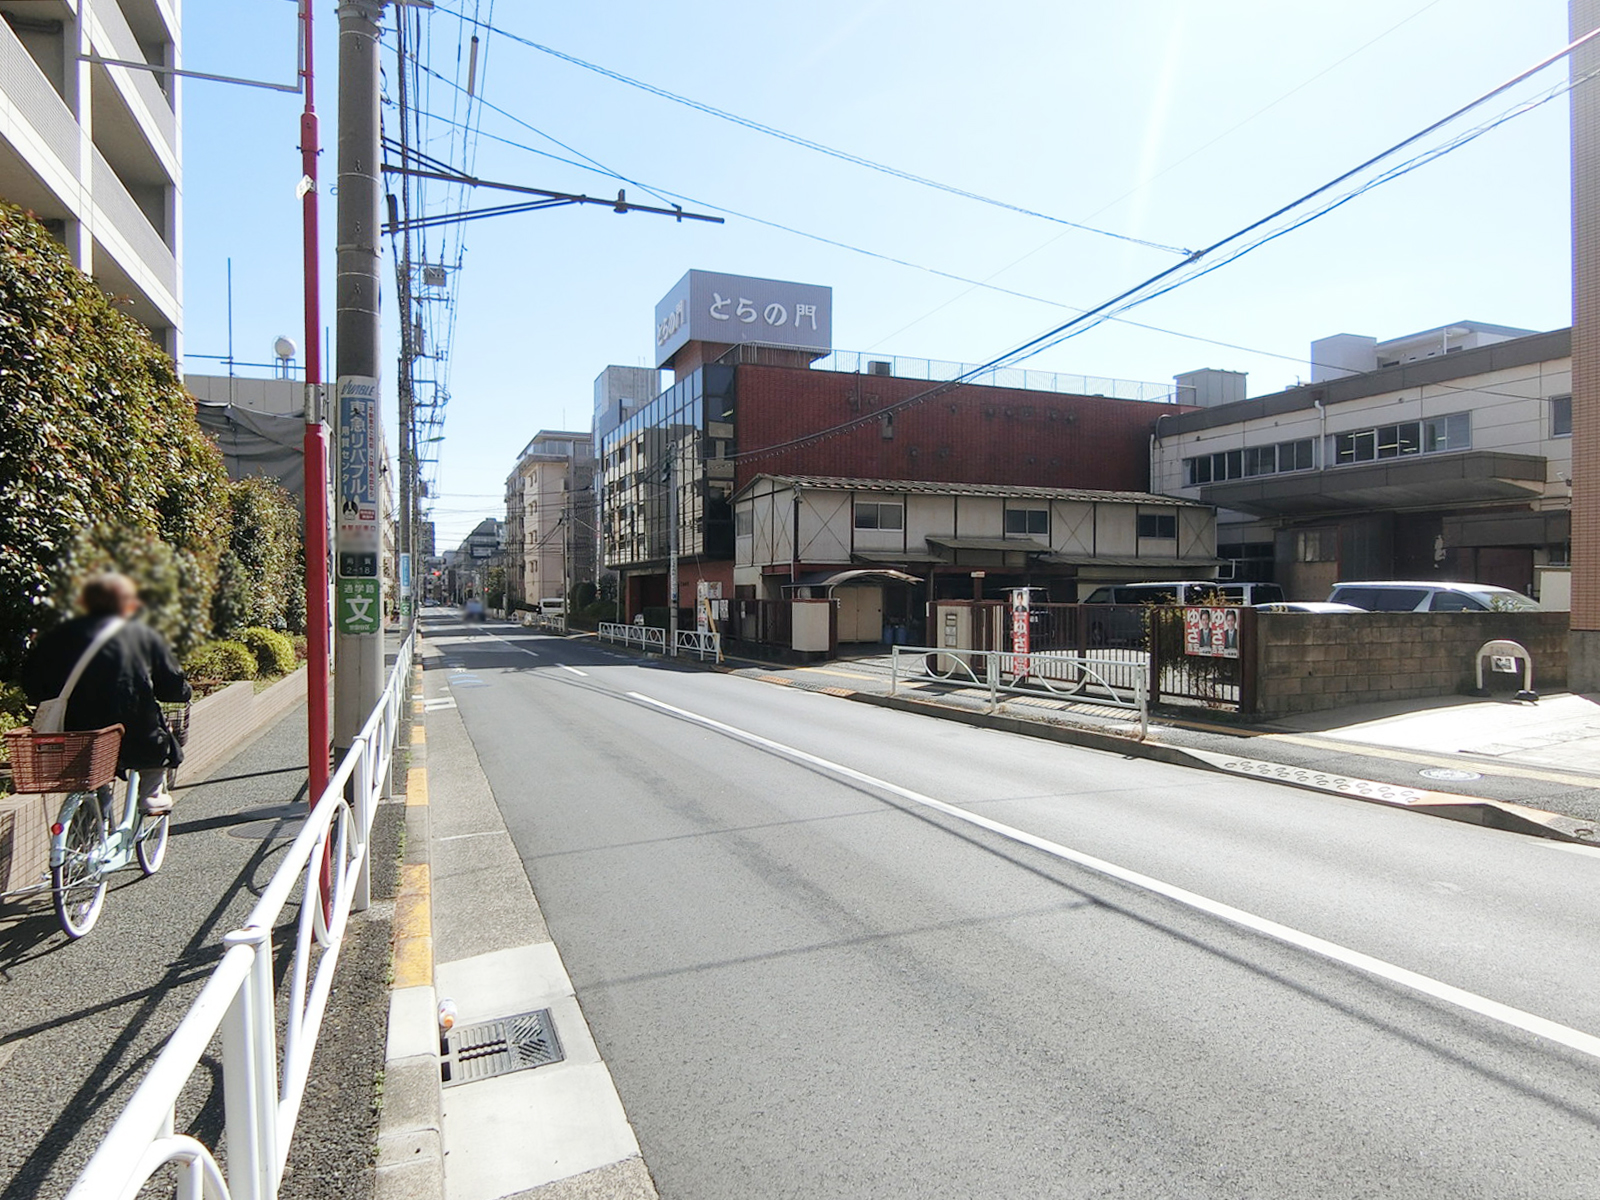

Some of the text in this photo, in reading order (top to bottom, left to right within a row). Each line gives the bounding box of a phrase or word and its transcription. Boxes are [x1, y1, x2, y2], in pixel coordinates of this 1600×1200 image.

[656, 299, 686, 347] とらの門
[709, 292, 818, 330] とらの門
[350, 401, 366, 494] 東急リバブル
[344, 584, 374, 593] 通学路
[1187, 609, 1200, 644] ゆさ
[1212, 609, 1225, 645] ゆさ
